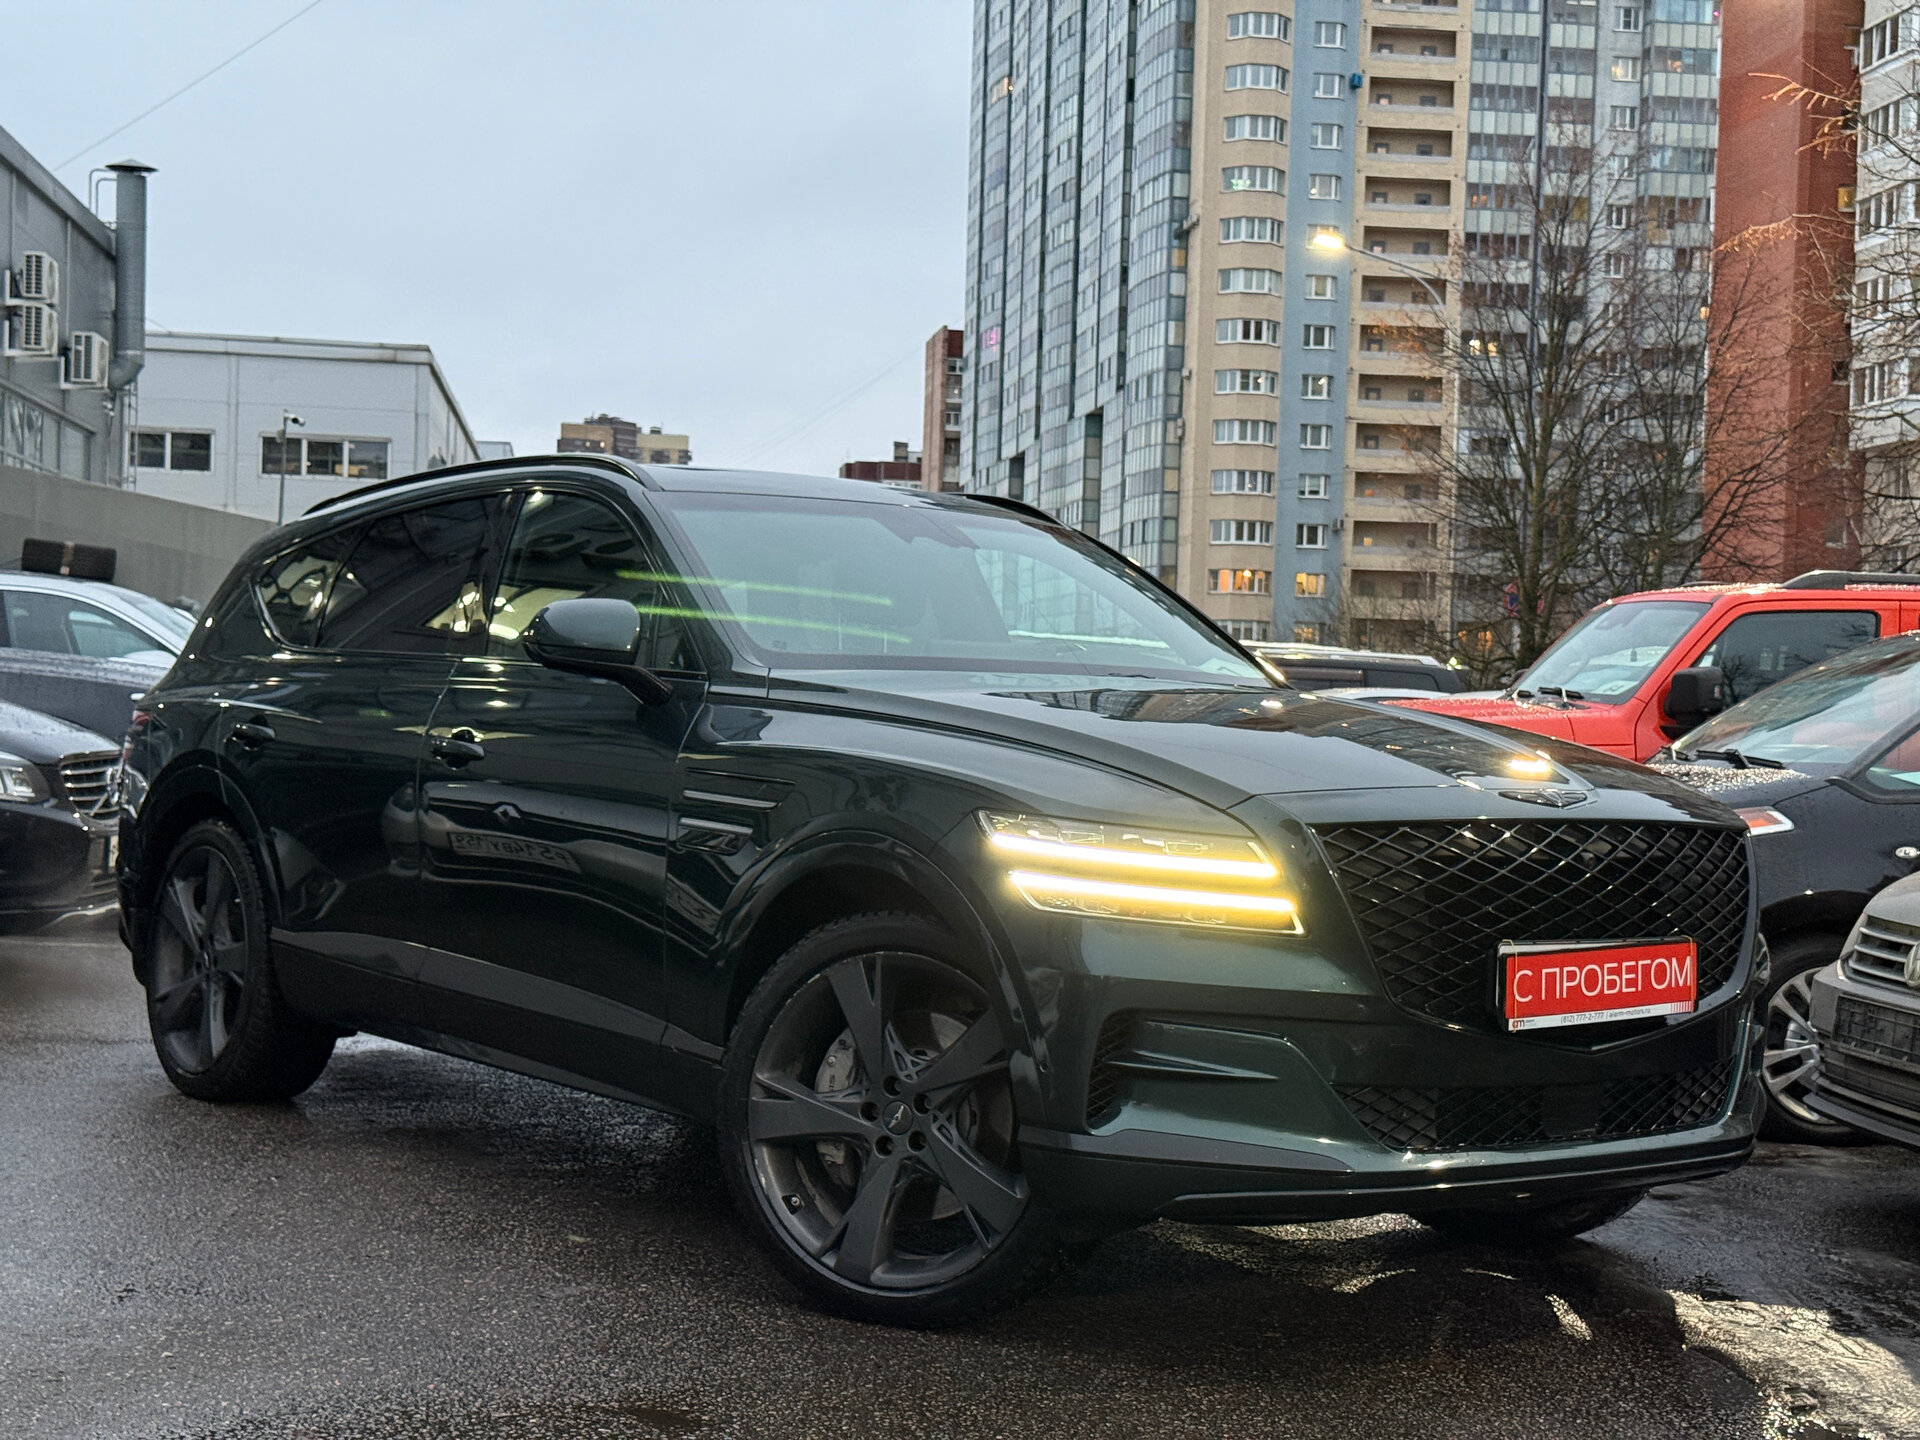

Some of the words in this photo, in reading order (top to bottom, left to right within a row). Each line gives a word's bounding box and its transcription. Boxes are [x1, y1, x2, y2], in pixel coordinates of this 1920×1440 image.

[1514, 970, 1533, 1003] С
[1542, 956, 1691, 1000] ПРОБЕГОМ
[1560, 1015, 1575, 1024] (812)
[1575, 1011, 1604, 1021] 777-2-777
